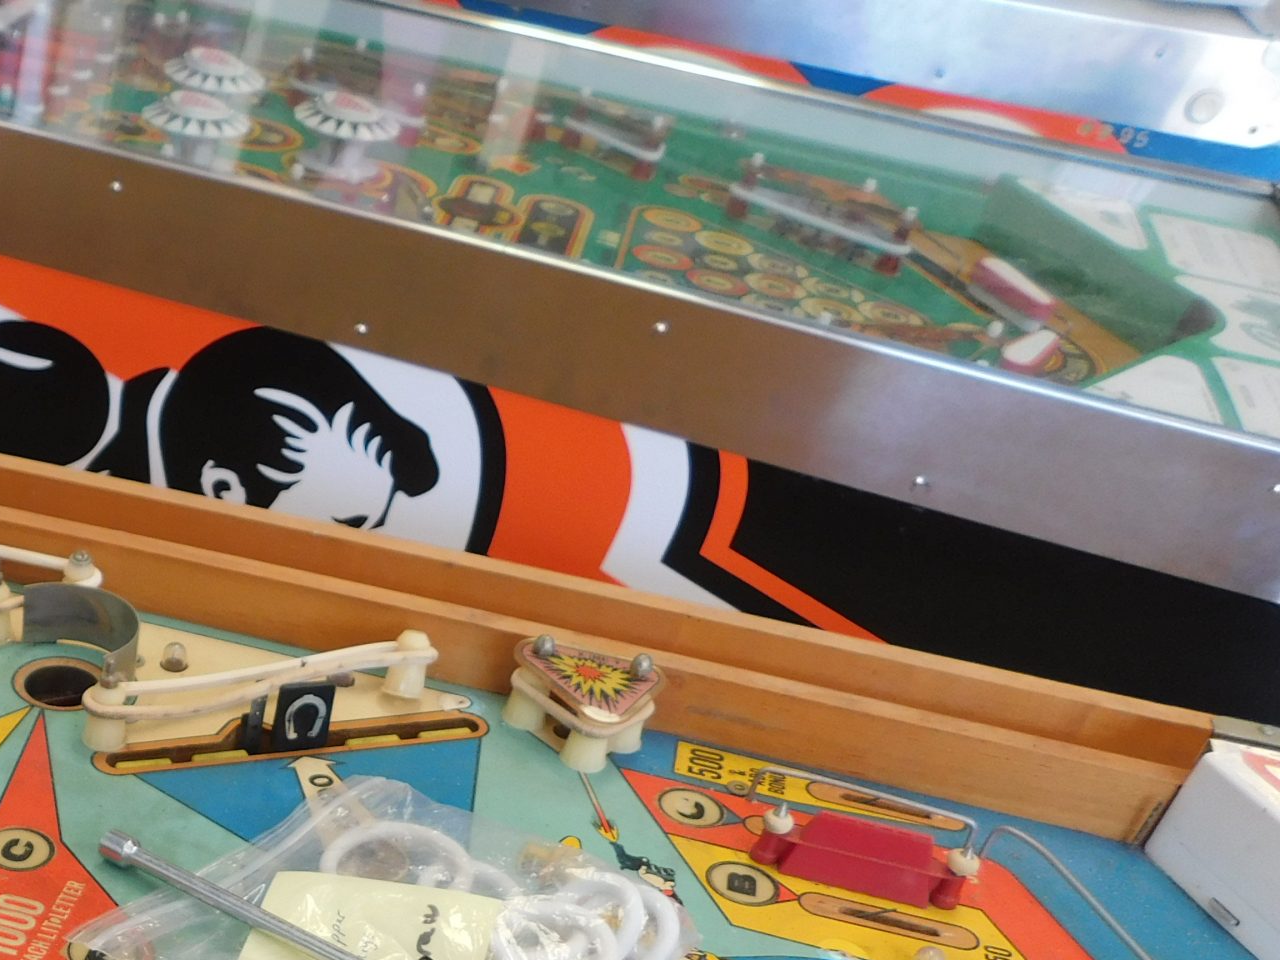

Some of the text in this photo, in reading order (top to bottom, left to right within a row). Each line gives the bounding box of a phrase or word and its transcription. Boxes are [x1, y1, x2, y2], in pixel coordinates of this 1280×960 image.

[688, 748, 725, 780] 500
[767, 773, 786, 796] BONU
[1, 837, 35, 862] C
[727, 871, 758, 898] B
